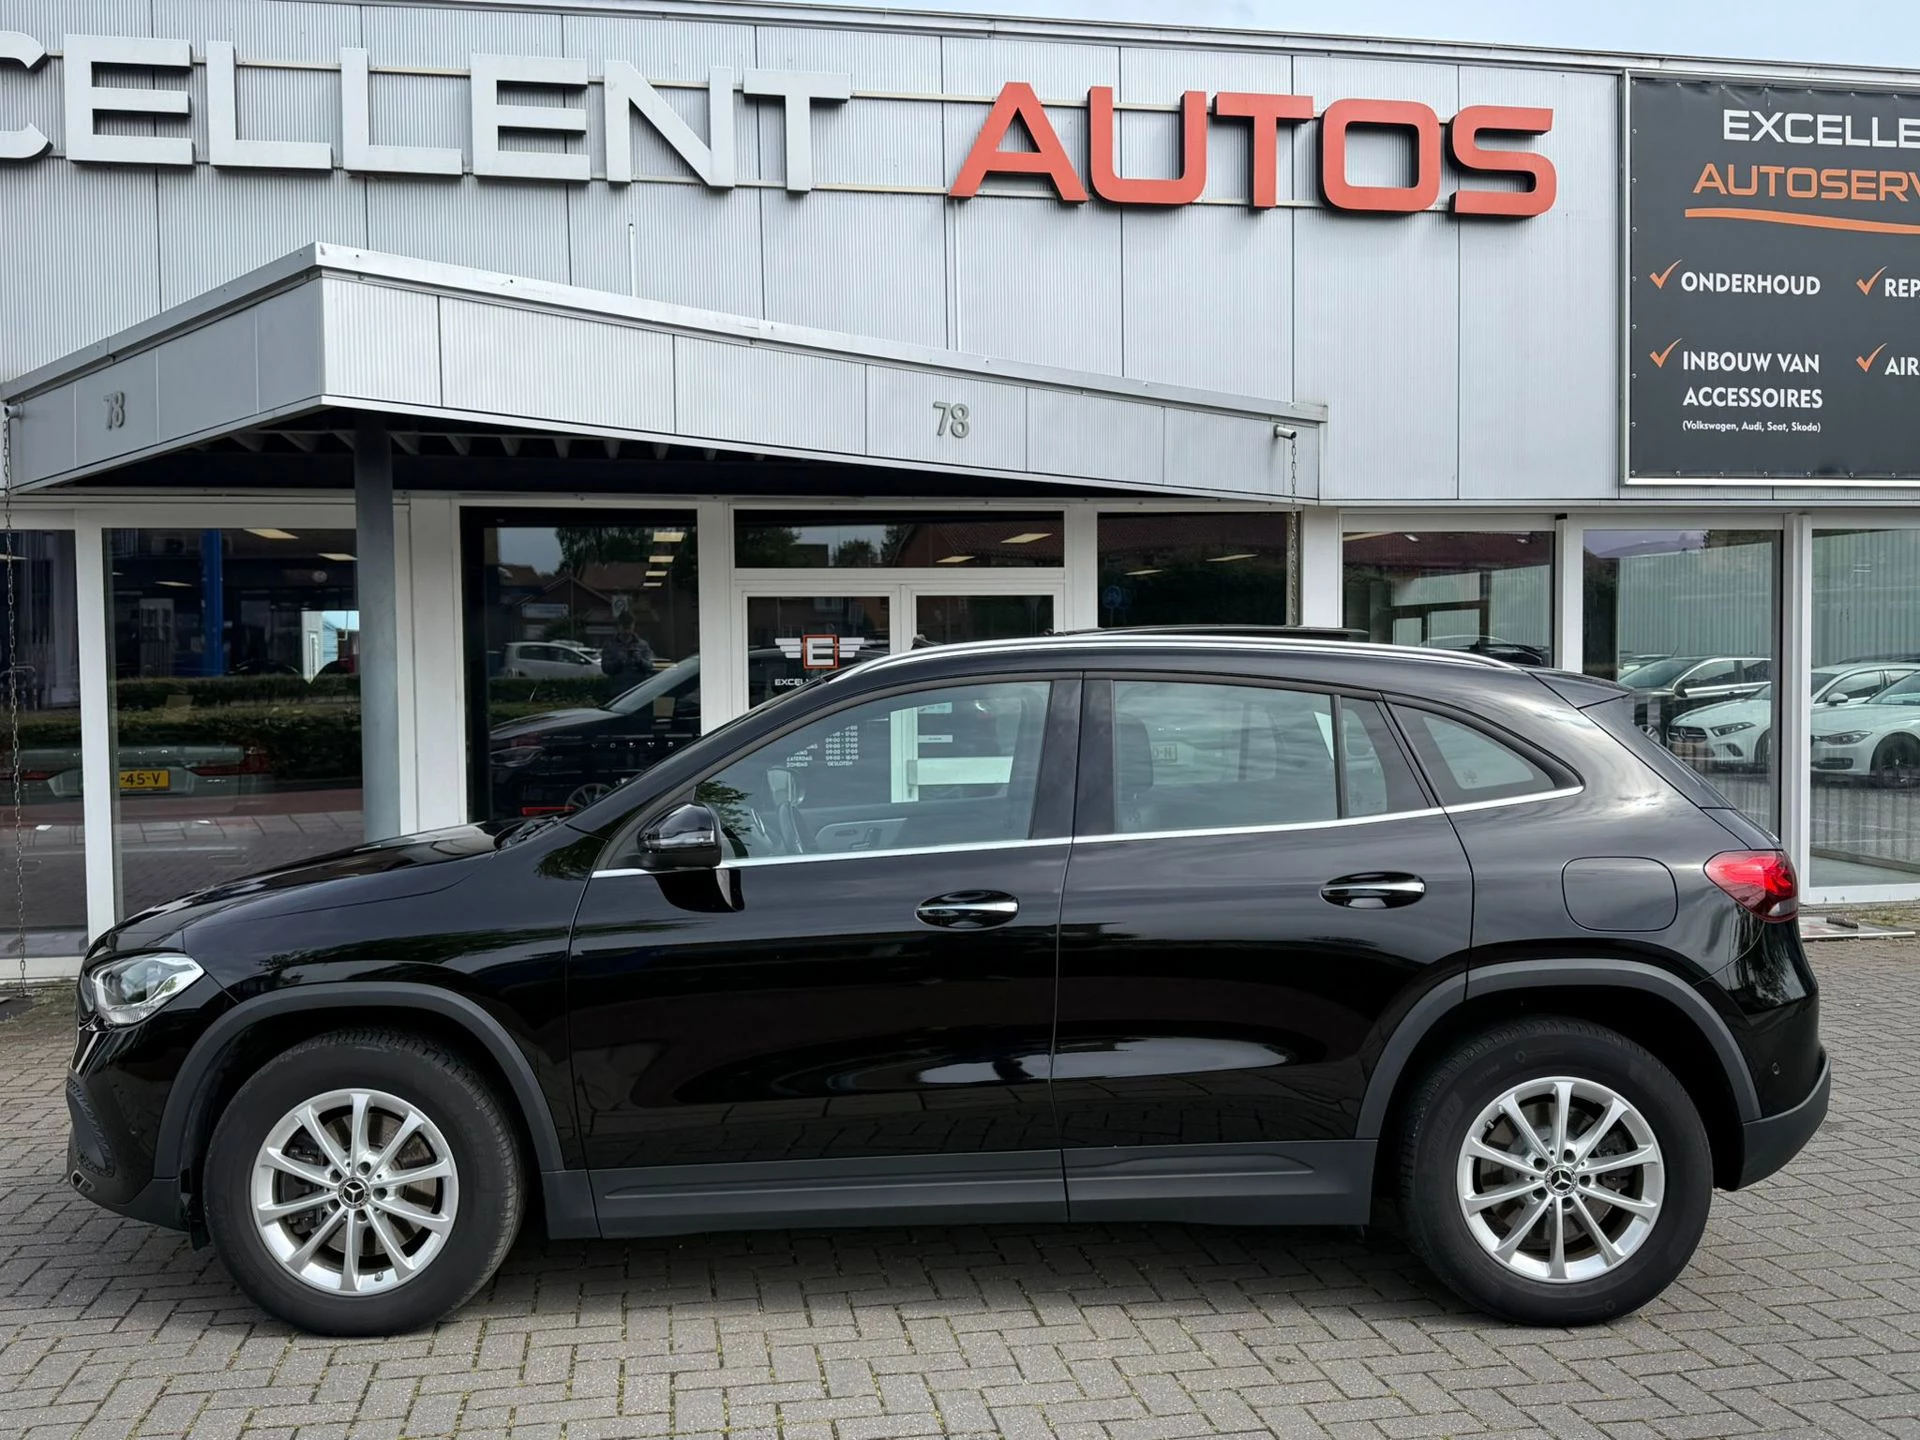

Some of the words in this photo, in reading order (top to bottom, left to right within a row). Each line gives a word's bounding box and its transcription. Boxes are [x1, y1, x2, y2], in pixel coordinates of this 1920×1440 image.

[1723, 109, 1920, 149] EXCELLE
[948, 81, 1557, 217] AUTOS
[1681, 272, 1821, 295] ONDERHOUD
[1683, 351, 1771, 373] INBOUW
[1777, 353, 1820, 374] VAN
[102, 391, 126, 431] 78
[1682, 387, 1823, 409] ACCESSOIRES
[932, 400, 970, 439] 78
[1682, 420, 1739, 432] (Volkswagen,
[1741, 421, 1765, 432] Audi,
[1767, 421, 1789, 432] Seat,
[1791, 421, 1821, 433] Skoda)
